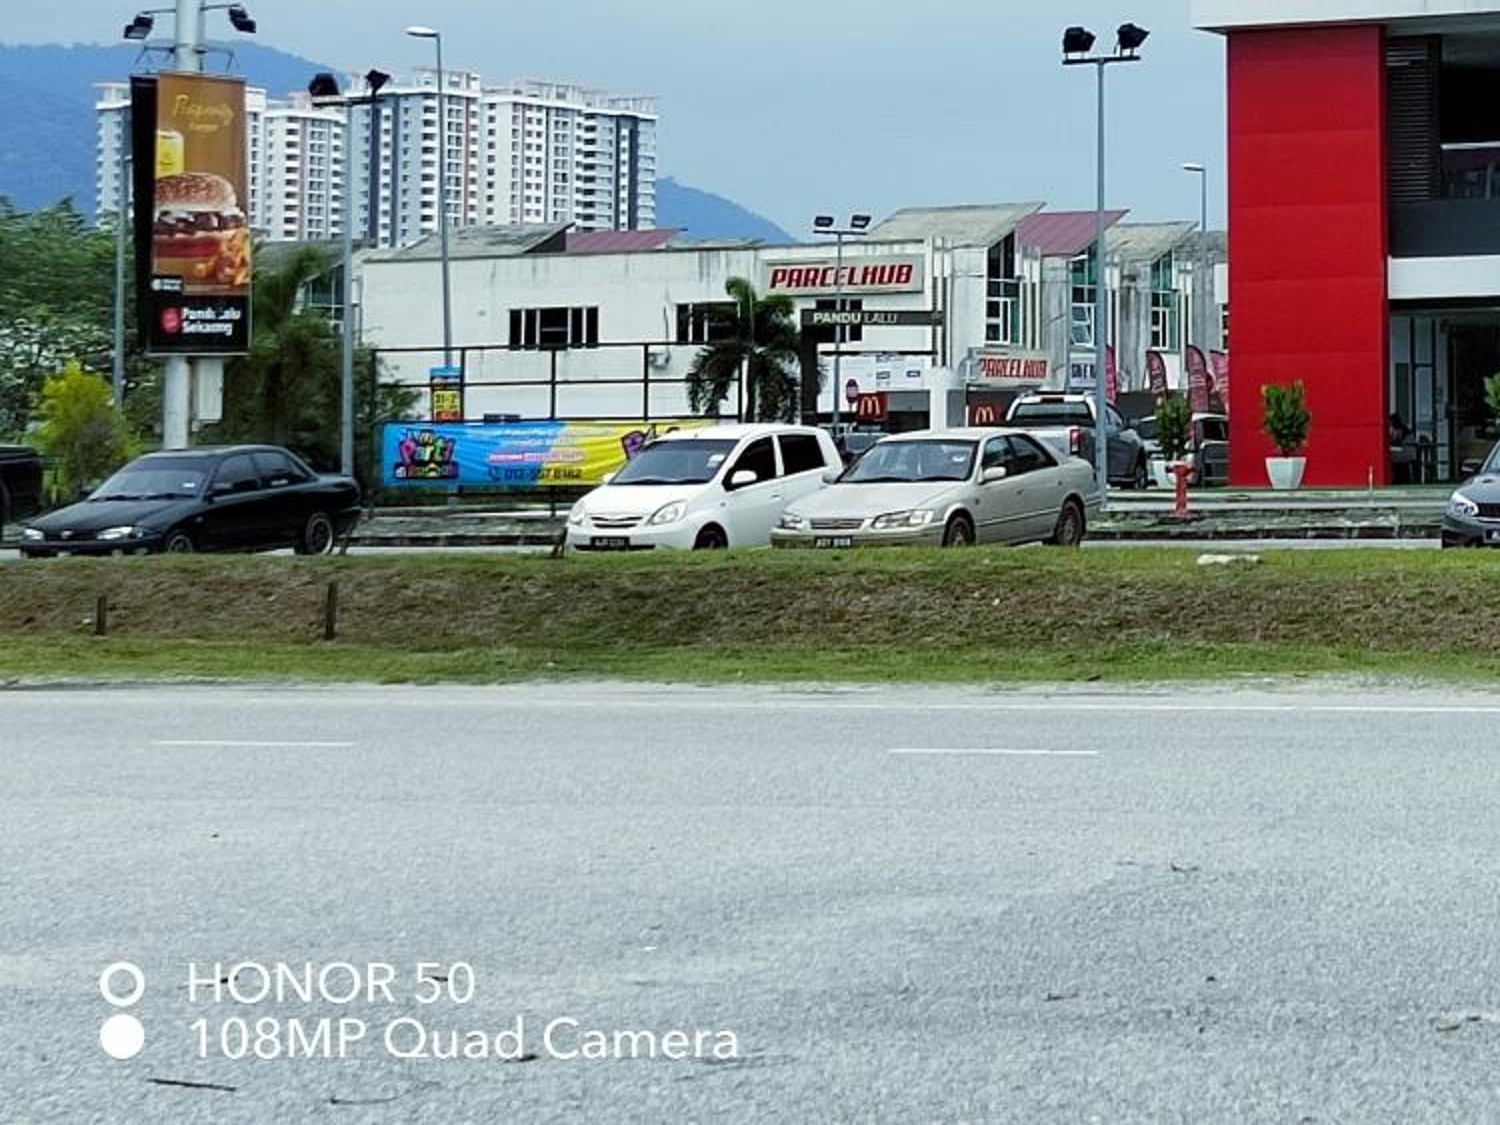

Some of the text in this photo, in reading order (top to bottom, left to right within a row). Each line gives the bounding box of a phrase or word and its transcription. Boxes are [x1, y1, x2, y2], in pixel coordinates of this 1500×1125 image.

[769, 264, 913, 289] PARCELHUB
[812, 312, 898, 324] PANDU LALU
[979, 357, 1049, 380] PARCELHUB
